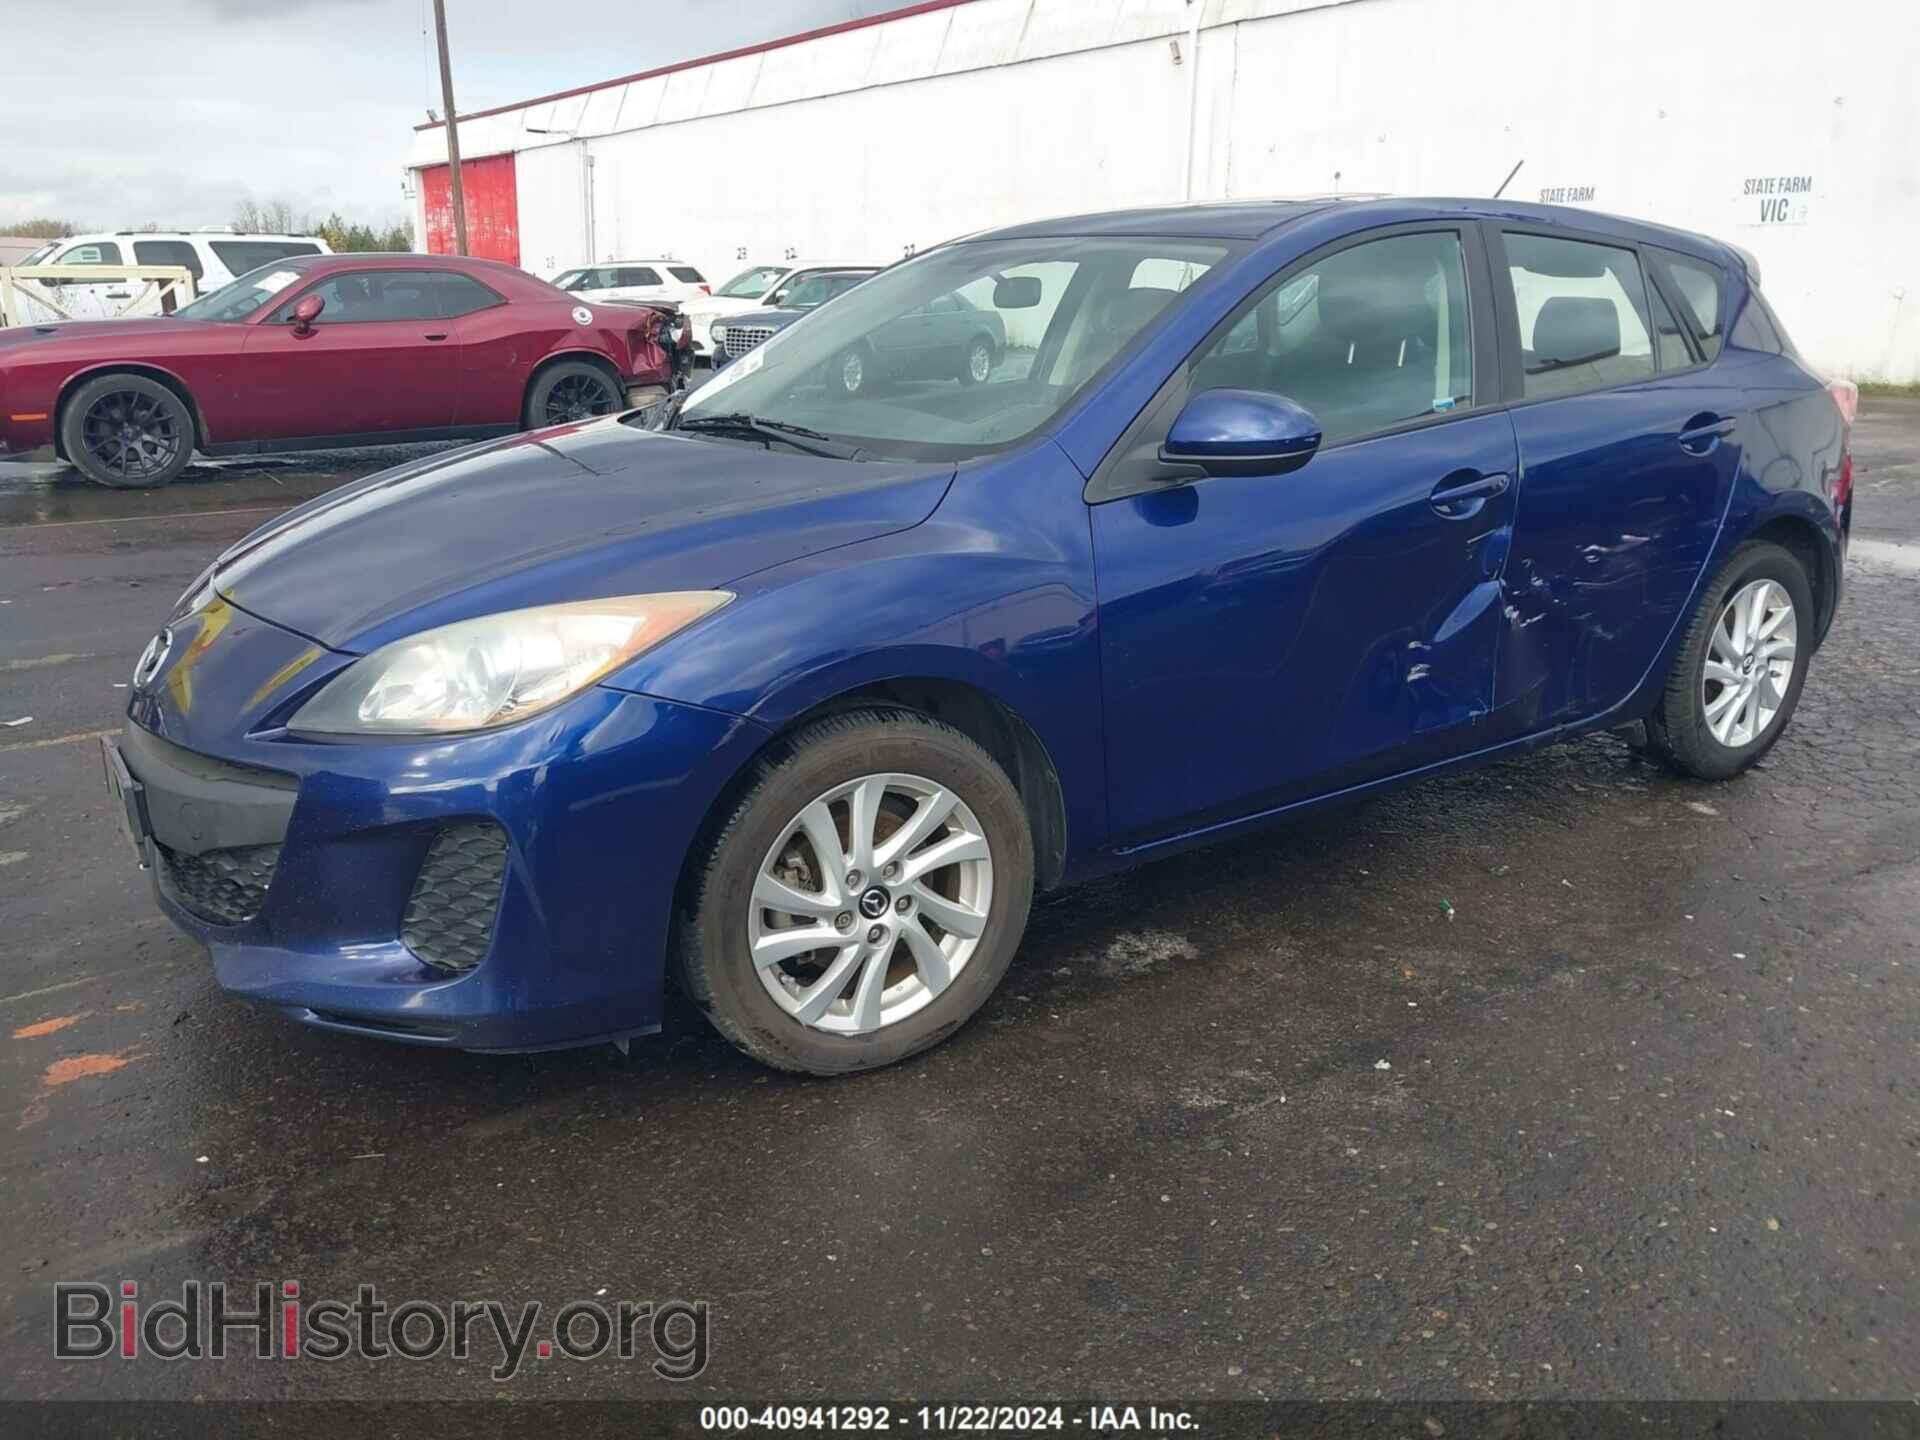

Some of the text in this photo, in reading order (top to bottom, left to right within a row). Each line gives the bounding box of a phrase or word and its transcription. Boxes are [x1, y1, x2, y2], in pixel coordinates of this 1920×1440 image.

[1540, 186, 1595, 203] STATE FARM
[1743, 176, 1813, 195] STATE FARM
[1760, 198, 1789, 222] VIC
